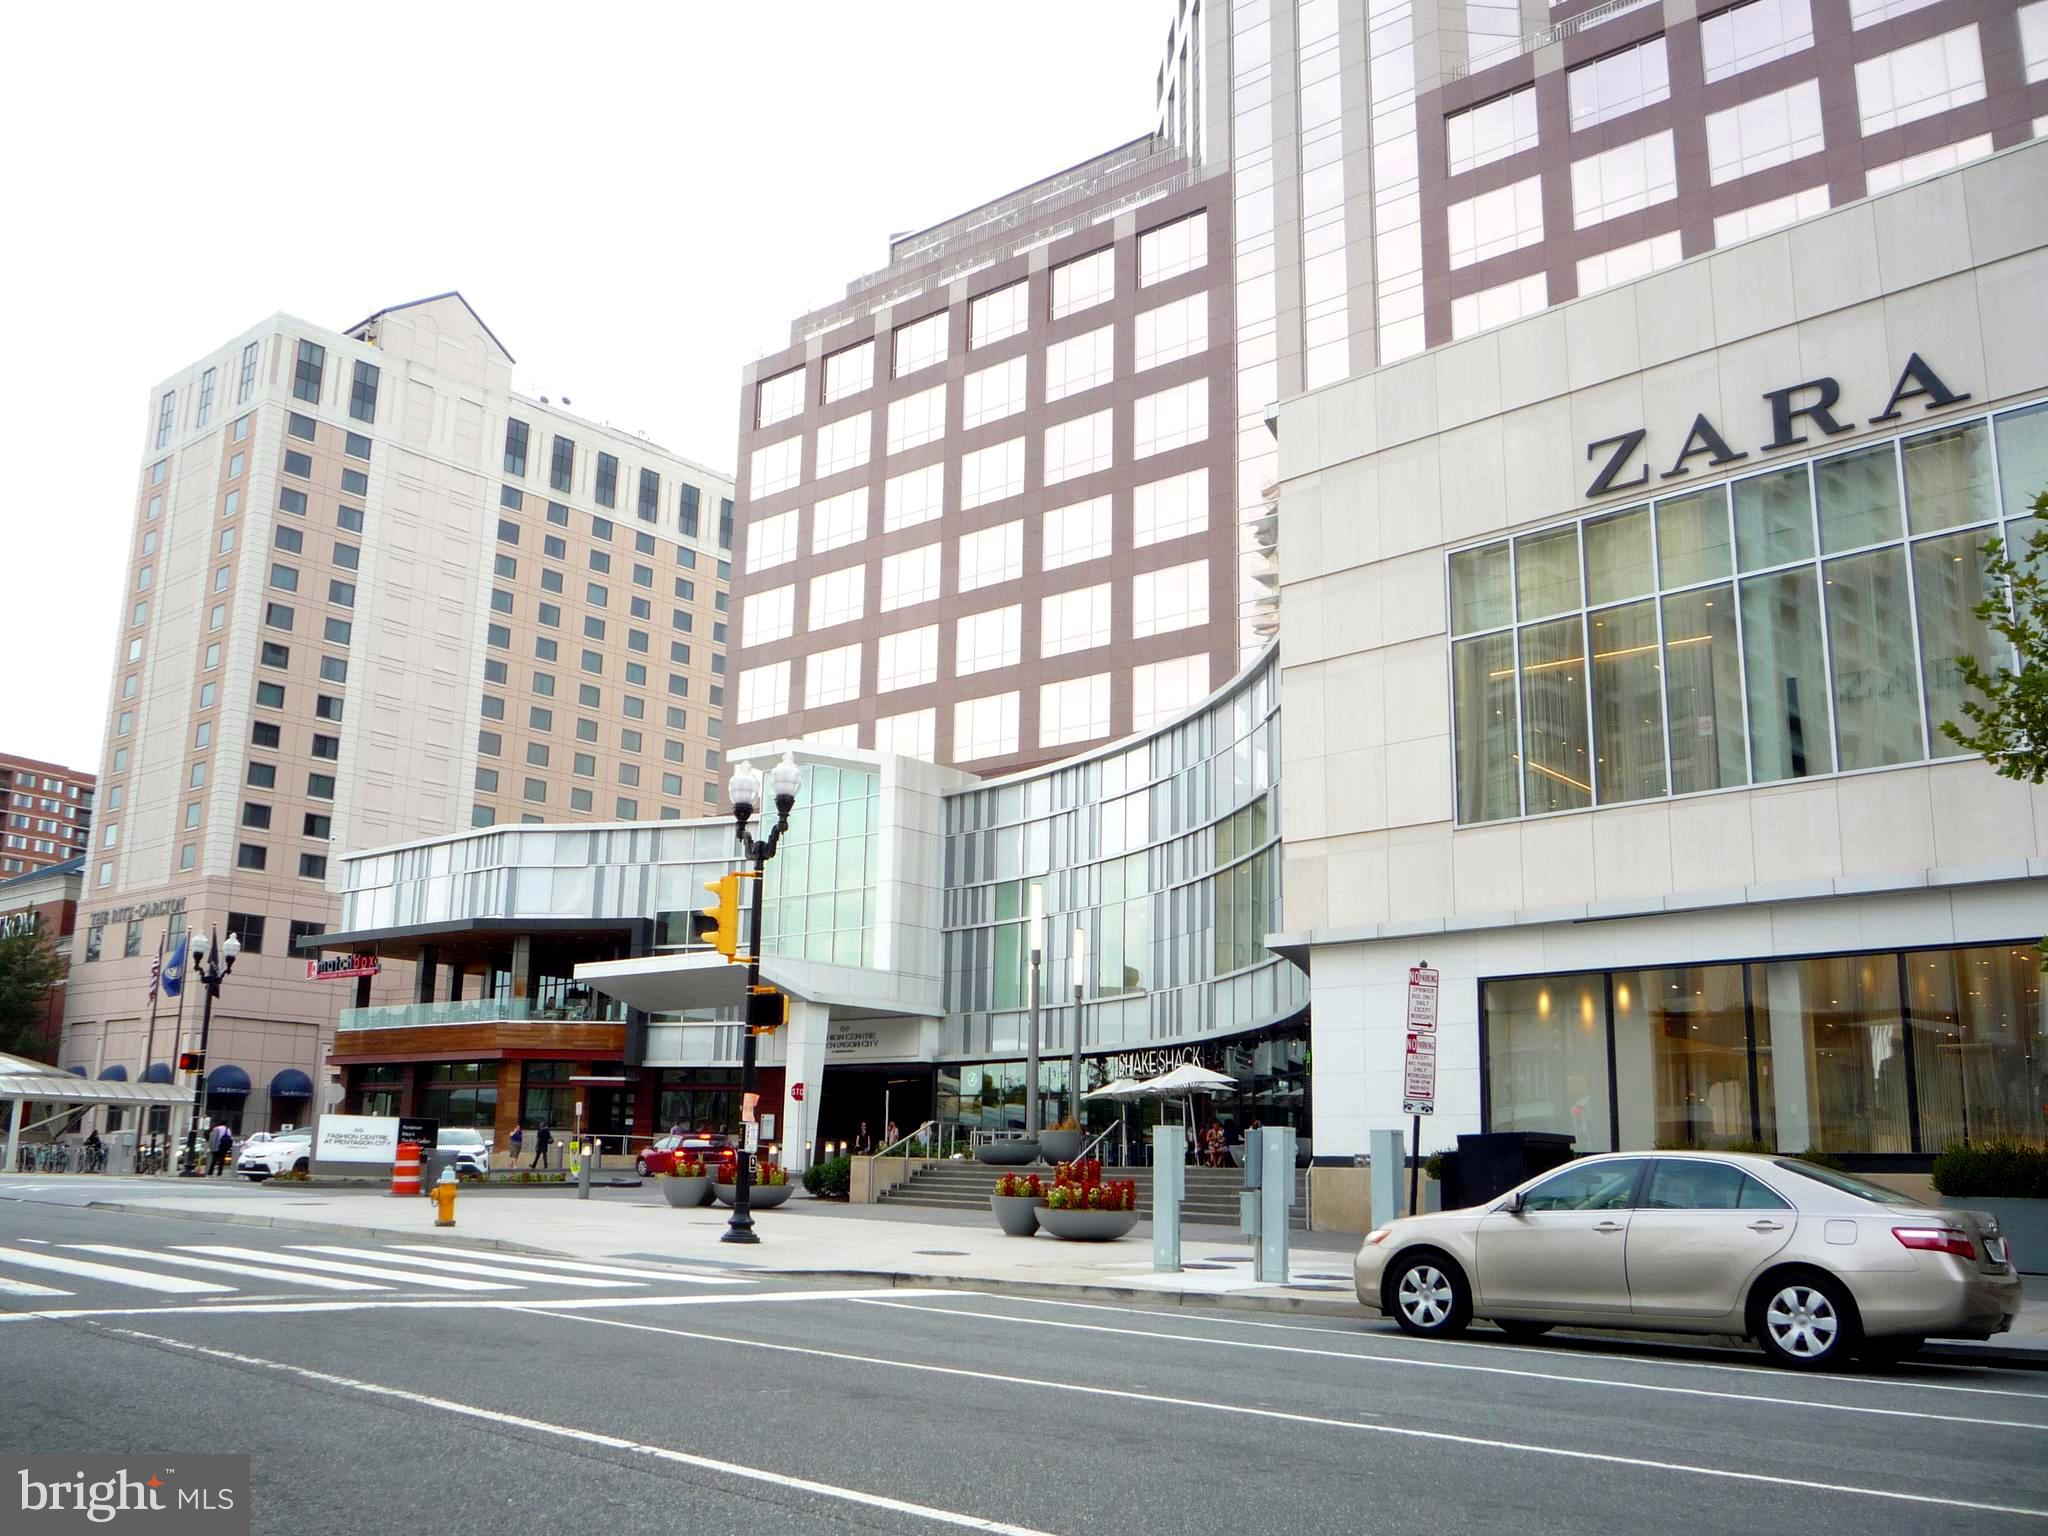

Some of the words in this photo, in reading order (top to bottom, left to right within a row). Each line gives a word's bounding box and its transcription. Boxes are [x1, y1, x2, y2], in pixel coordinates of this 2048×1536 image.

[1586, 352, 1971, 498] ZARA
[90, 911, 109, 926] THE
[1409, 970, 1419, 984] NO
[1419, 974, 1437, 983] PARKING
[1407, 1039, 1416, 1050] NO
[1416, 1041, 1434, 1050] PARKING
[1118, 1051, 1157, 1077] SHAKE
[1158, 1046, 1201, 1074] SHACK
[792, 1087, 804, 1096] STO
